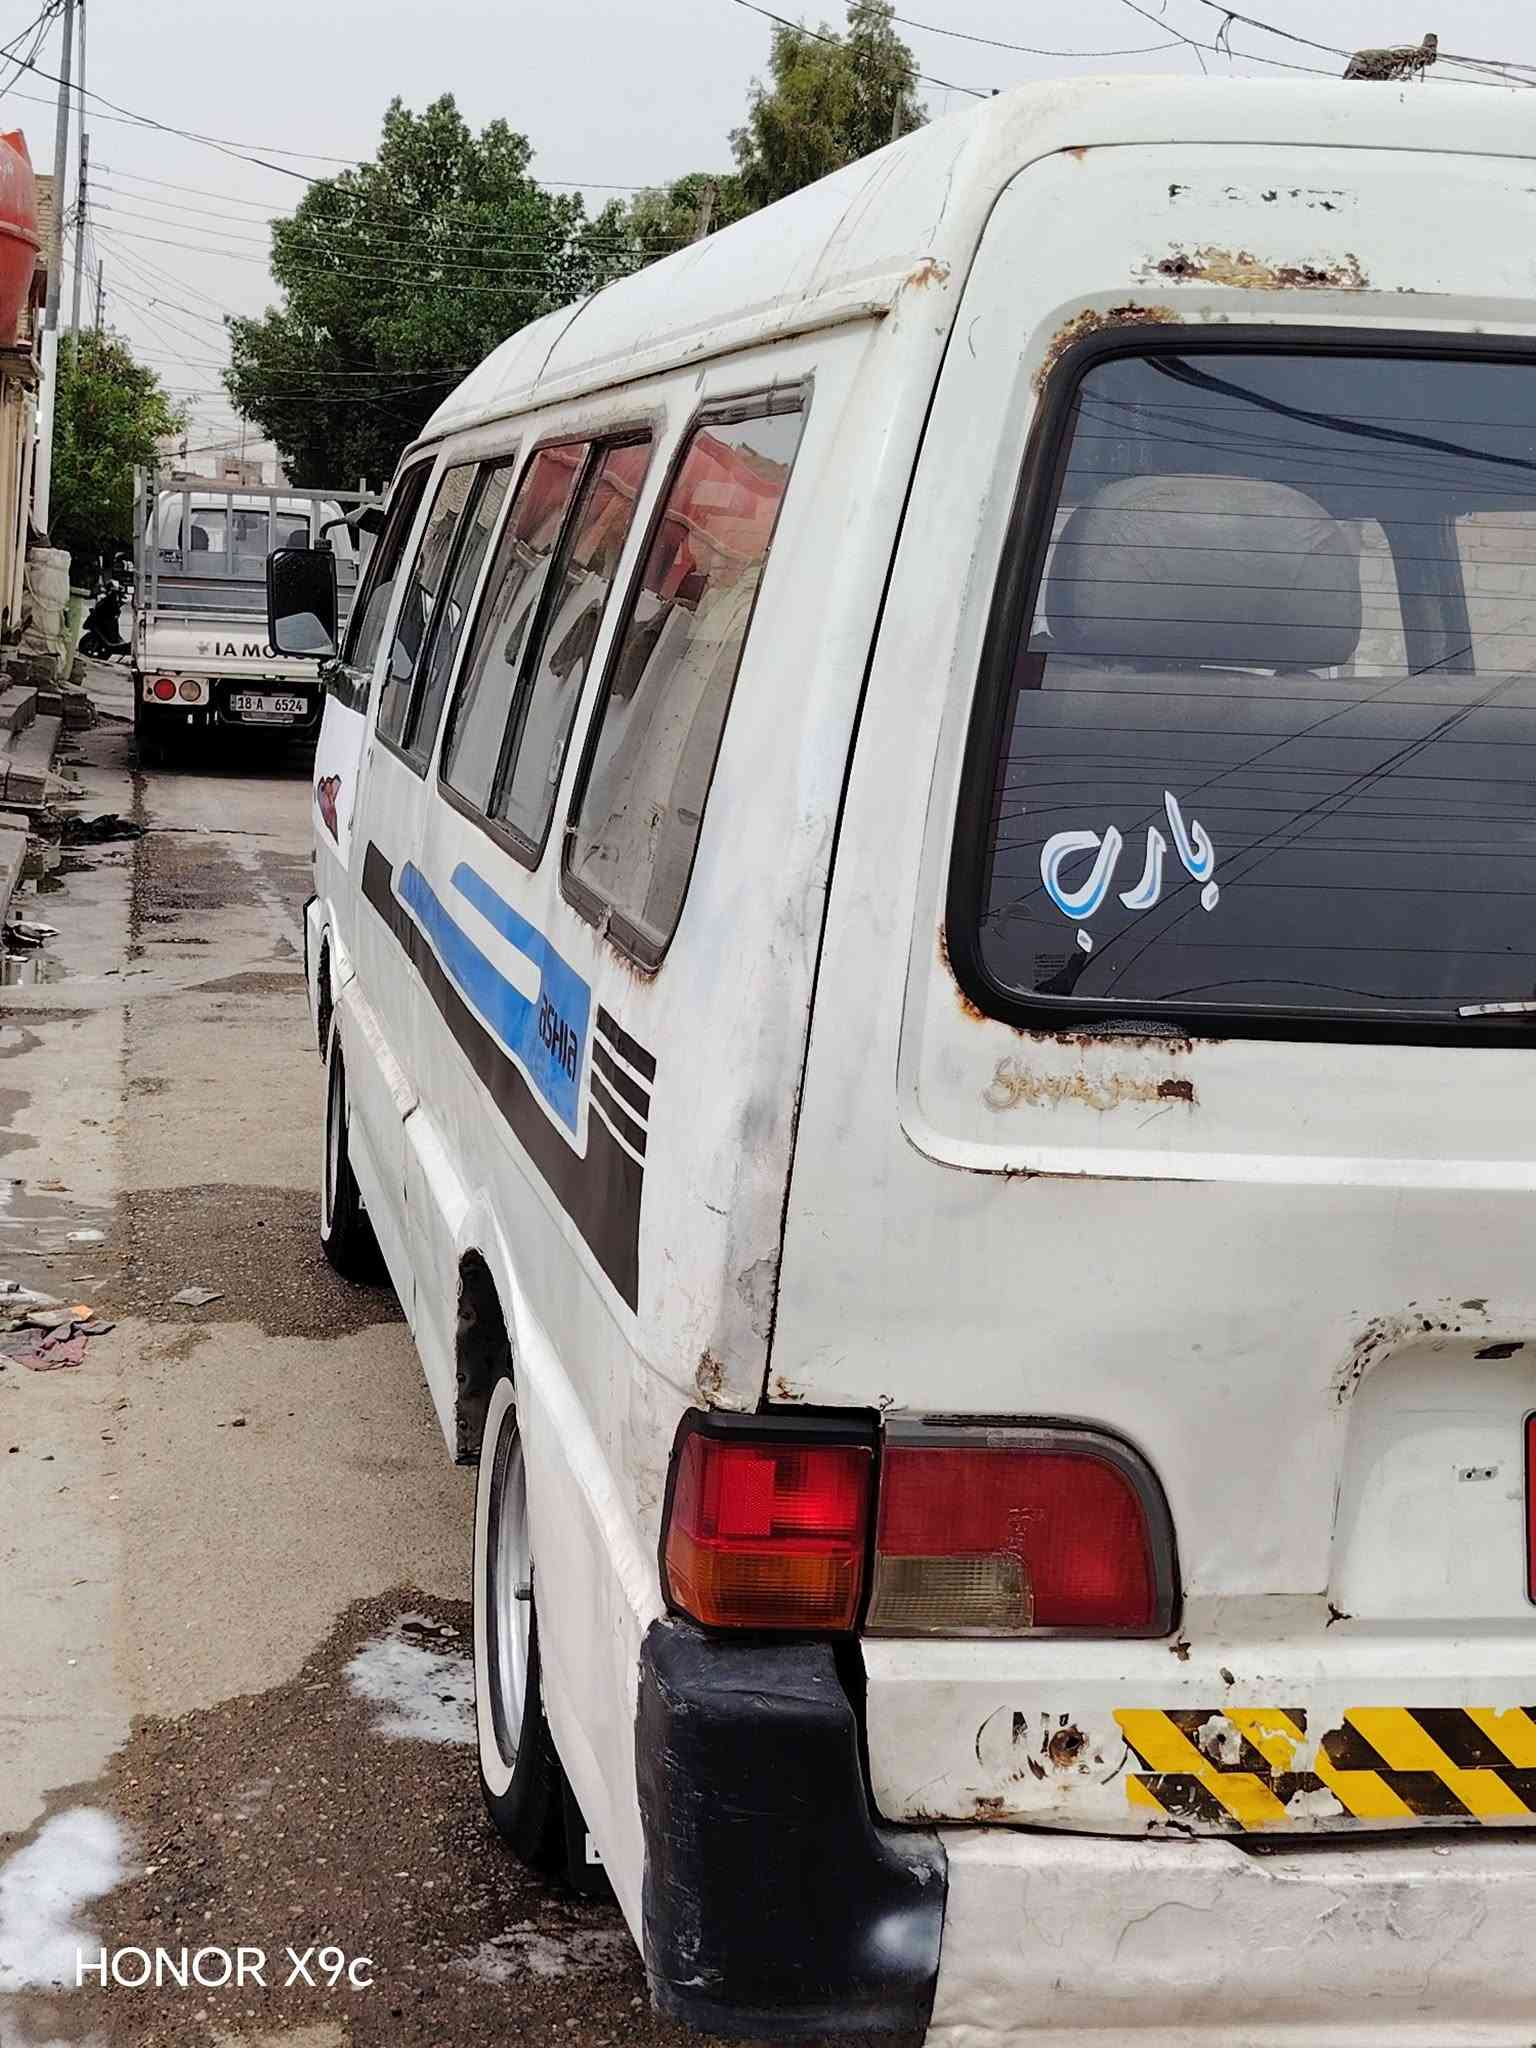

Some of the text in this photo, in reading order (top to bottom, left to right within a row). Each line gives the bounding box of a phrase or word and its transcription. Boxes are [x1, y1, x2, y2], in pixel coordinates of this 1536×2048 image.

[238, 697, 302, 712] 18 A 6524
